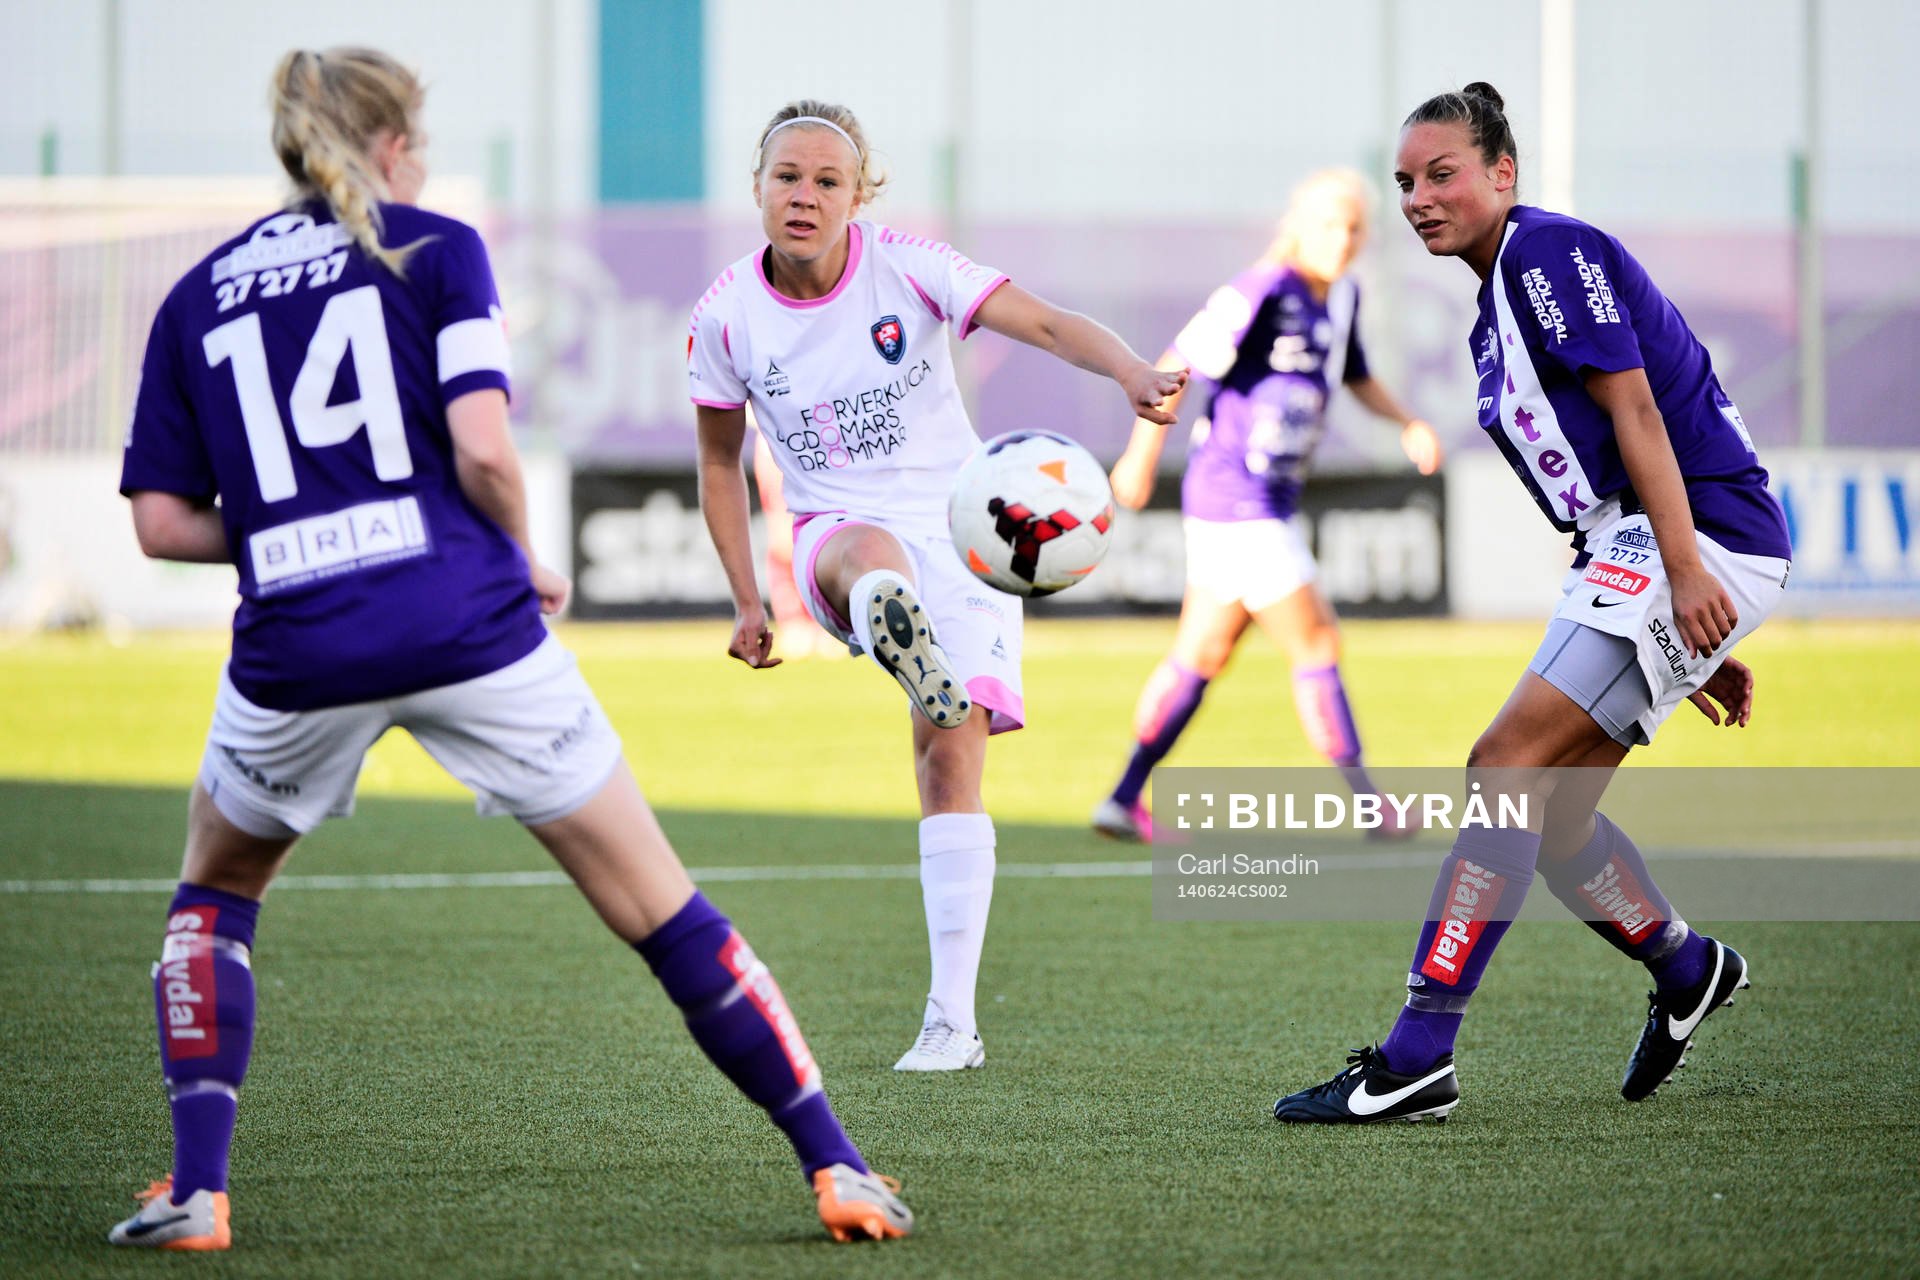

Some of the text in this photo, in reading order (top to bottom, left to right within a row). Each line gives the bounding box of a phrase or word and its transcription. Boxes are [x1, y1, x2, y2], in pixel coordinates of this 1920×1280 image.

[215, 250, 349, 312] 27 27 27
[1521, 271, 1554, 330] ENERGI
[1529, 267, 1568, 345] MÖLNDAL
[1570, 246, 1608, 323] MÖLNDAL
[1588, 263, 1621, 323] ENERGI
[202, 284, 414, 504] 14
[800, 359, 932, 428] FÖRVERKLIGA
[1648, 618, 1688, 682] stadium
